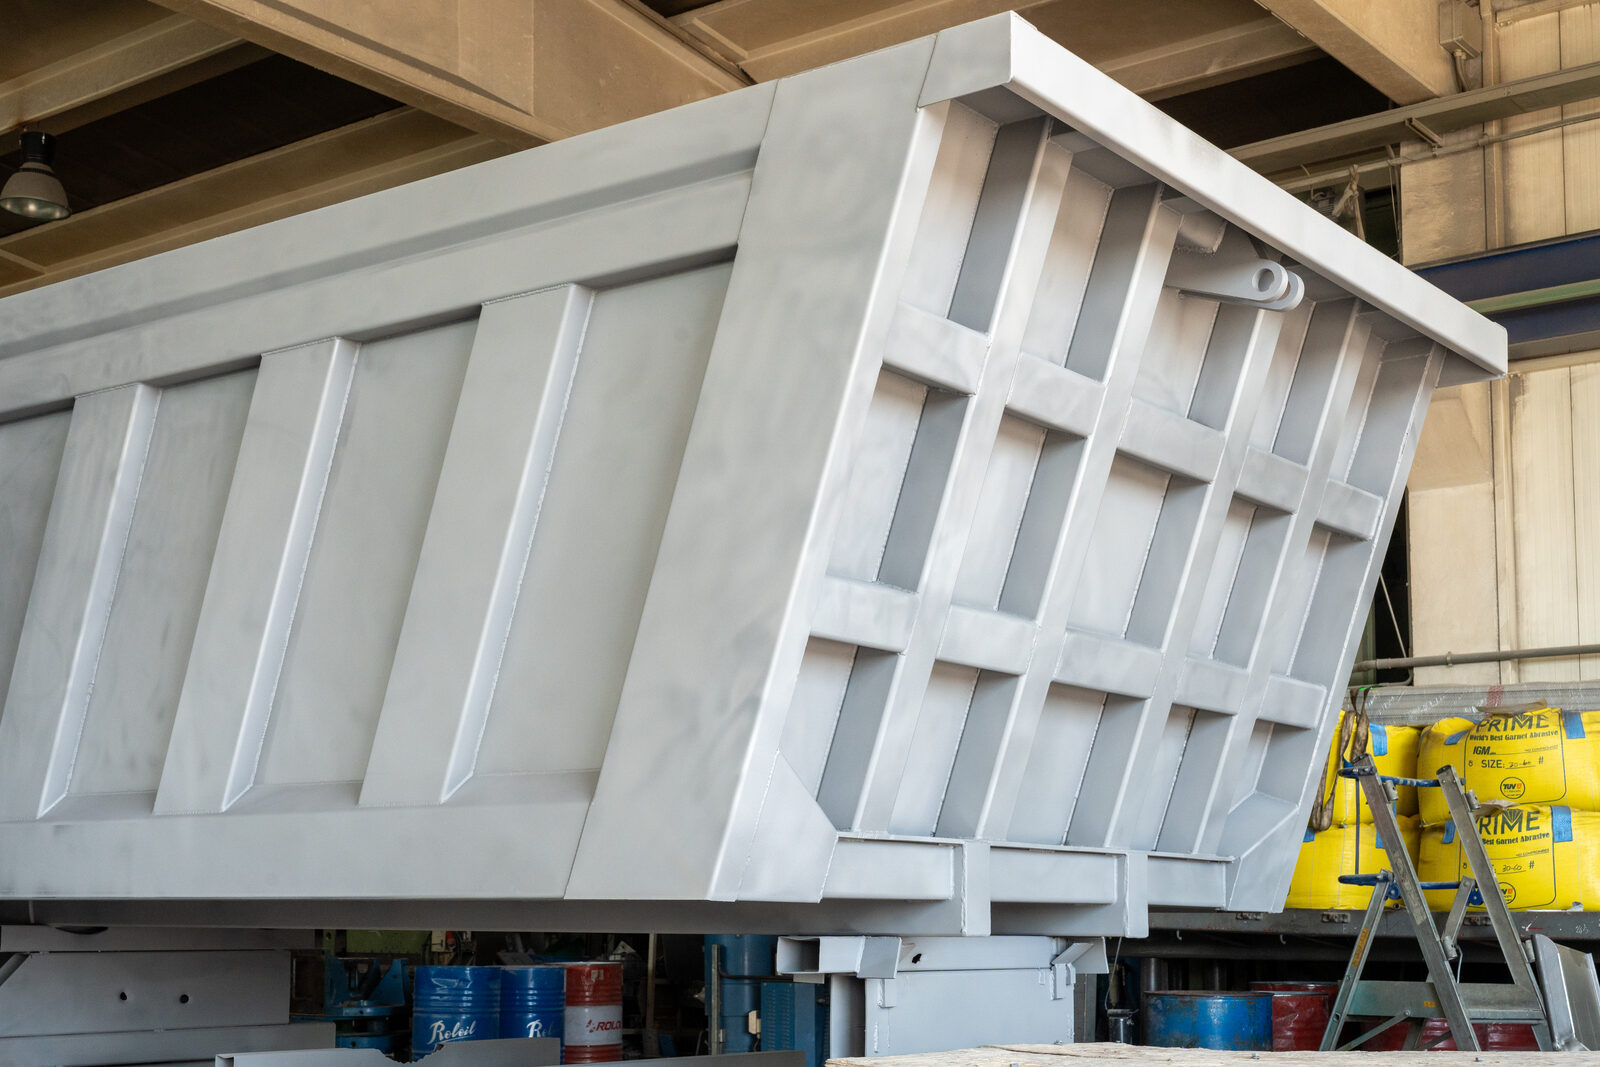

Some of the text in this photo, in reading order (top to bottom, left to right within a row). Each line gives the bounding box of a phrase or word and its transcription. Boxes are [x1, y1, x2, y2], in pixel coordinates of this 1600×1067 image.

[1476, 713, 1549, 733] PRIME
[1490, 733, 1503, 741] Best
[1505, 733, 1527, 741] Garnet
[1529, 730, 1558, 739] Abrasive
[1473, 746, 1490, 755] IGM
[1481, 759, 1505, 769] SIZE:
[1496, 836, 1519, 844] Garnet
[1520, 832, 1550, 842] Abrasive
[426, 1020, 476, 1045] Roloil
